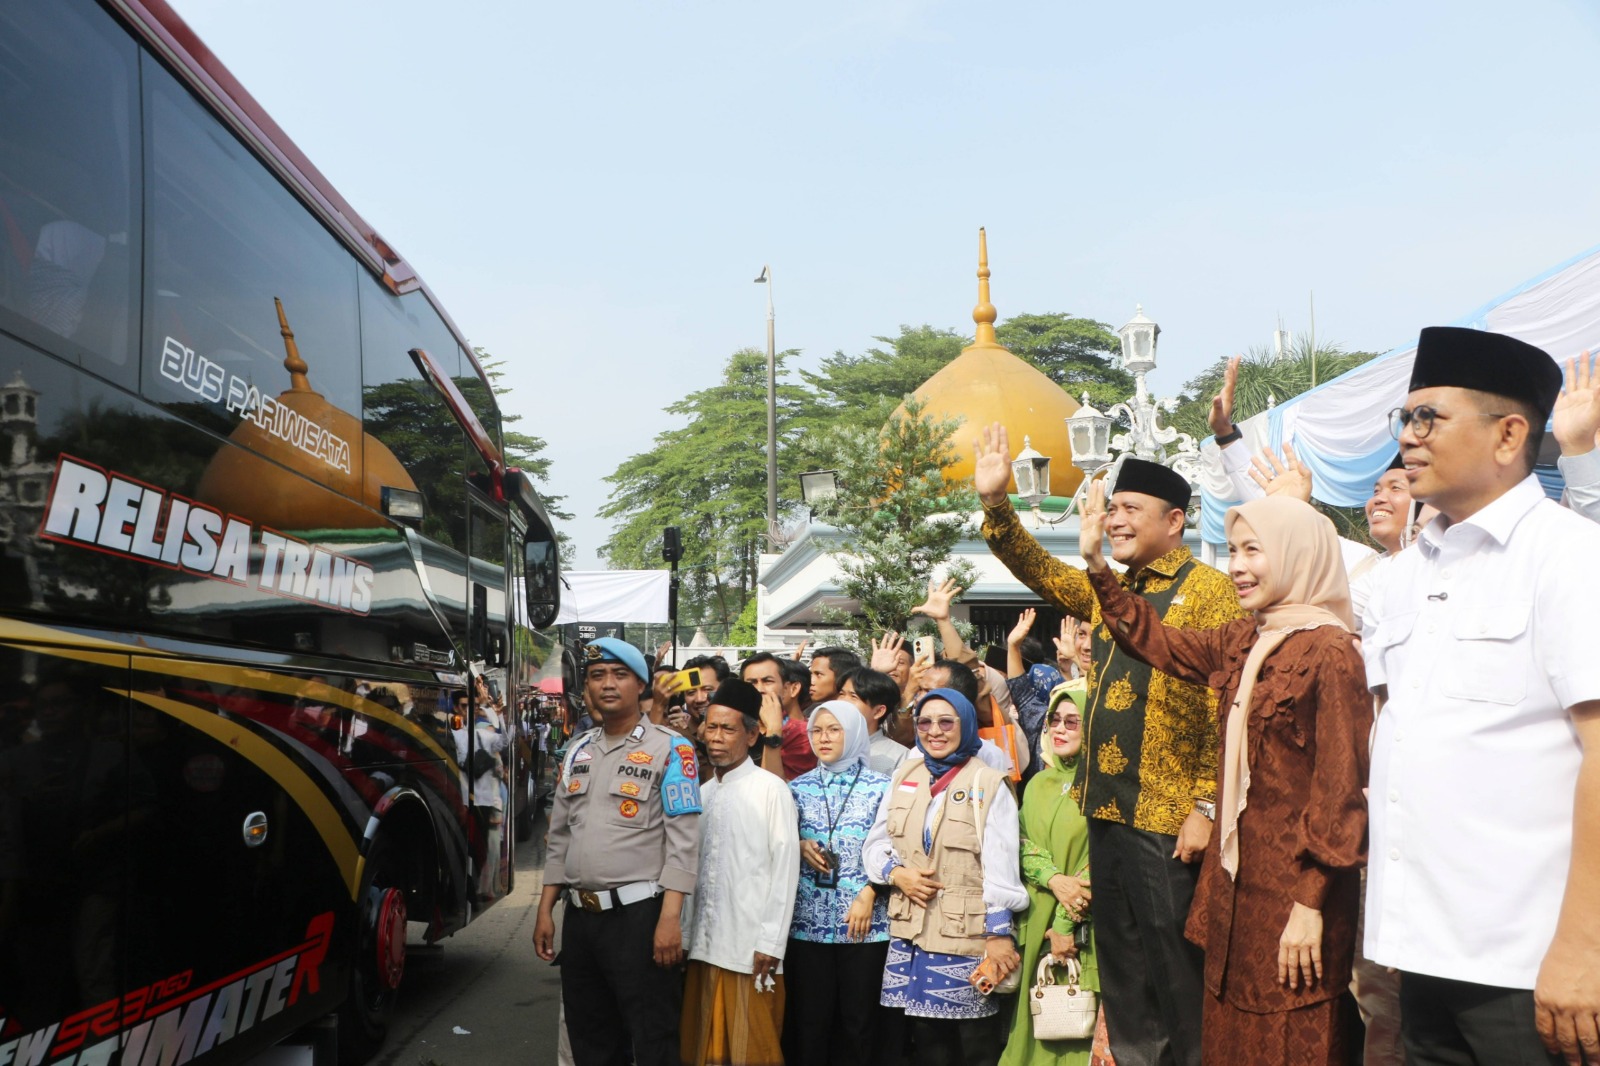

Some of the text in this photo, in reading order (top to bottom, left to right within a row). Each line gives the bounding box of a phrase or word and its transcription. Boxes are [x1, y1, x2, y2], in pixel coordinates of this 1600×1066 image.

[160, 336, 350, 474] BUS PARIWISATA
[40, 453, 374, 617] RELISA TRANS
[618, 765, 652, 780] POLRI
